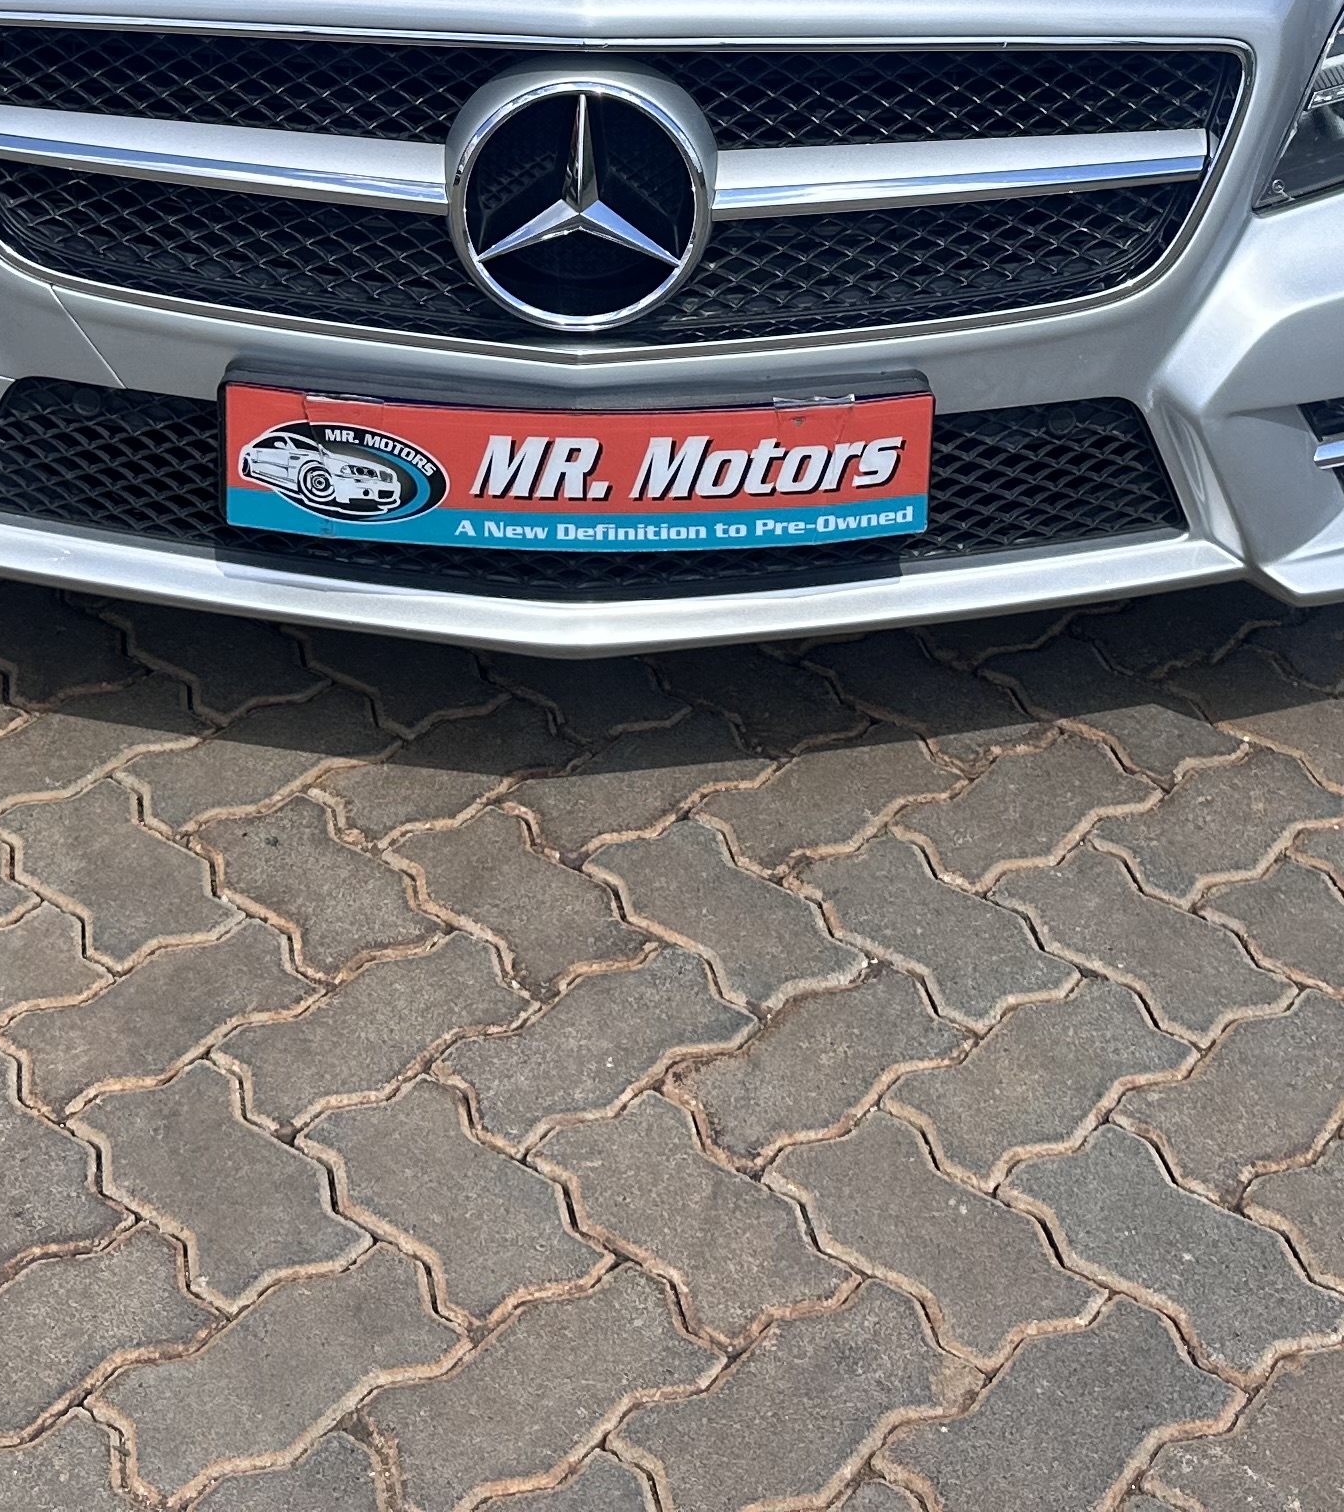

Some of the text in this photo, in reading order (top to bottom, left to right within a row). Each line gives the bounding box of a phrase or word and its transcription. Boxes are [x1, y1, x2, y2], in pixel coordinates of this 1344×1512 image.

[325, 428, 436, 476] MR. MOTORS
[469, 435, 905, 500] MR. Motors
[454, 506, 913, 540] A New Definition to Pre-Owned
